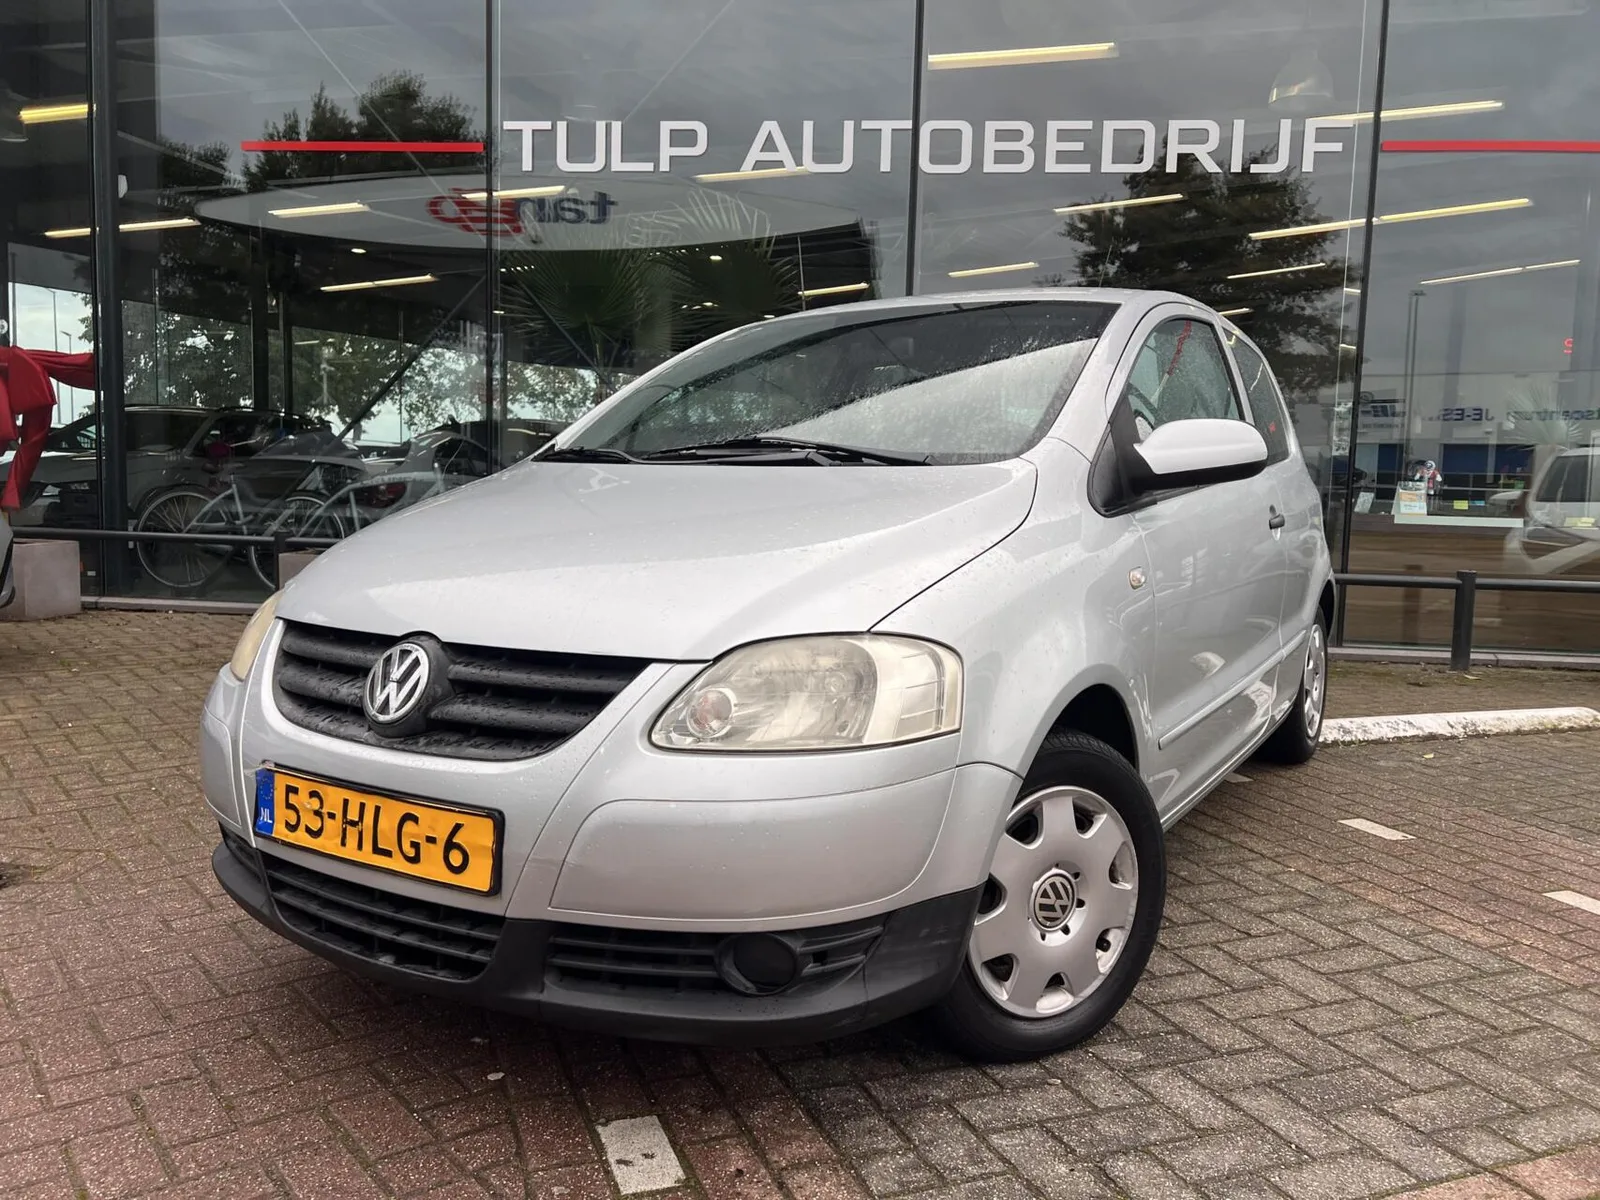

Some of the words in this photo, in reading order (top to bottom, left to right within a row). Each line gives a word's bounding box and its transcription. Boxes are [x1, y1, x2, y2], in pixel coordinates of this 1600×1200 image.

[502, 120, 709, 173] TULP
[739, 118, 1353, 174] AUTOBEDRIJF
[259, 806, 273, 824] NL
[284, 783, 470, 875] 53-HLG-6
